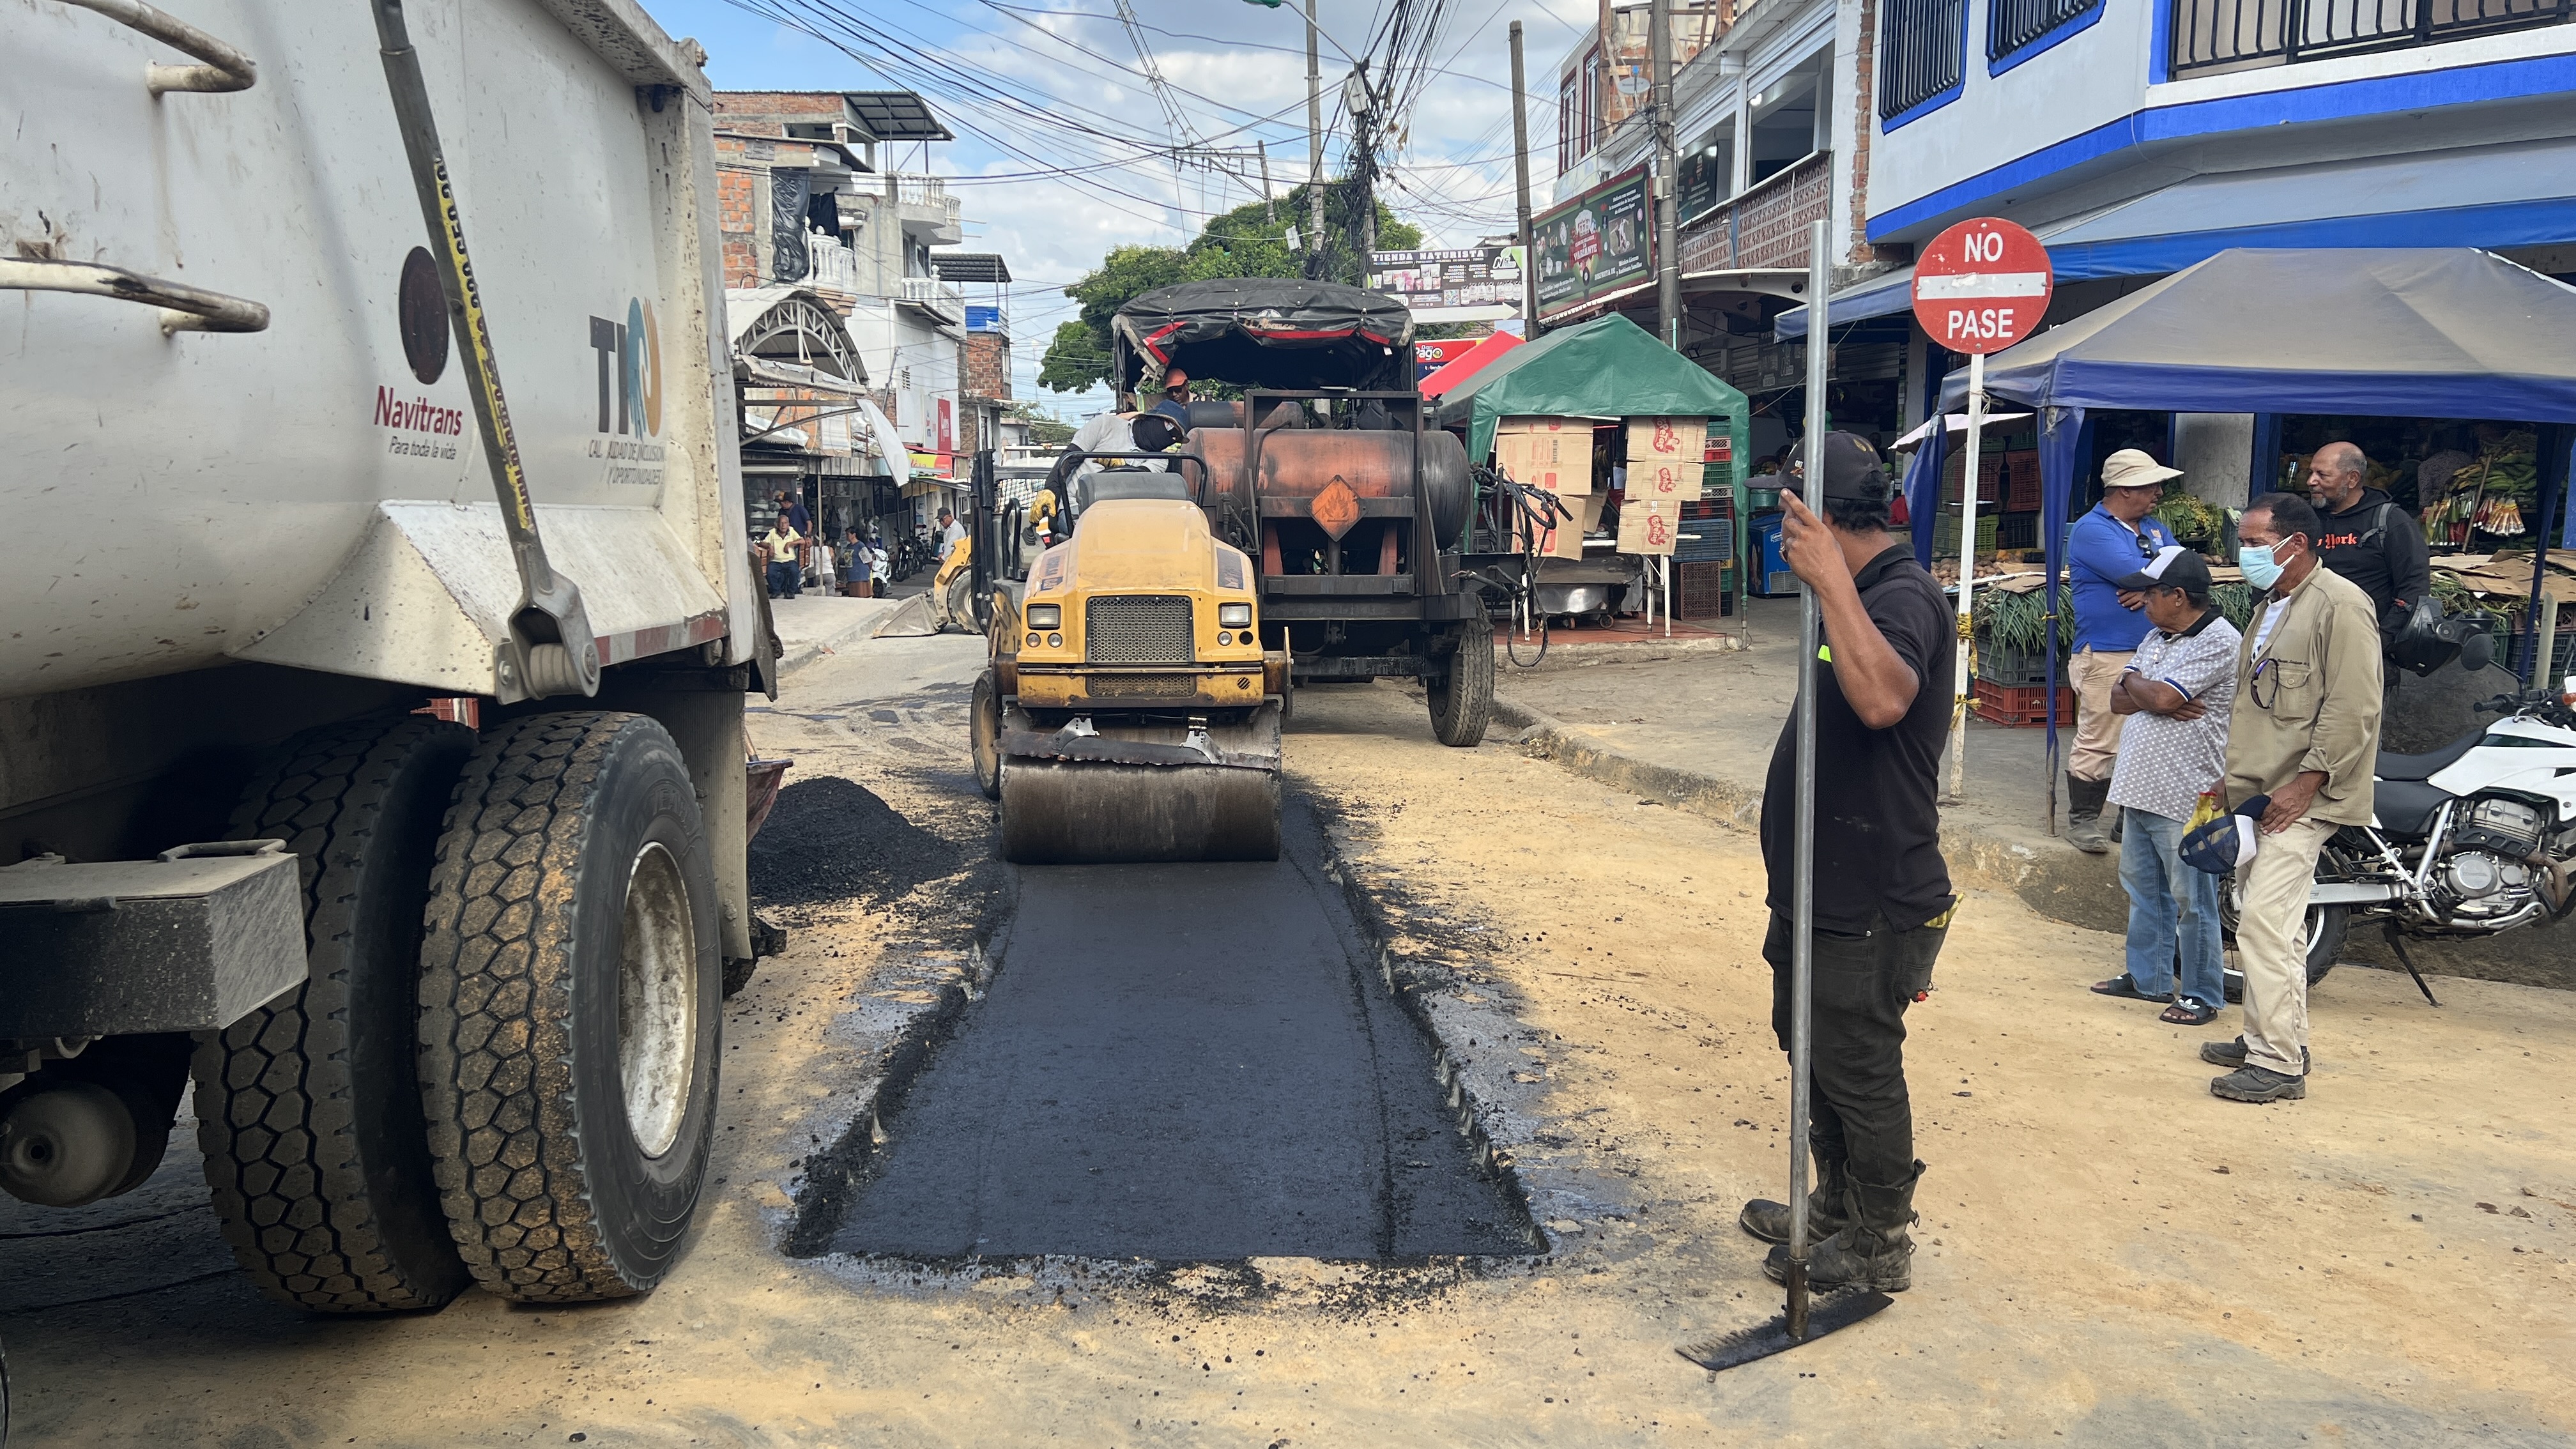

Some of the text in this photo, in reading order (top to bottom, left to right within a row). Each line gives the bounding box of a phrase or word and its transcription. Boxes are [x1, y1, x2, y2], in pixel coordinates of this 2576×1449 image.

[1372, 253, 1413, 262] TIENDA
[1419, 250, 1484, 260] NATURISTA
[1964, 232, 2004, 263] NO
[1947, 309, 2014, 339] PASE
[374, 385, 463, 436] Navitrans
[388, 435, 457, 460] Para toda la vida
